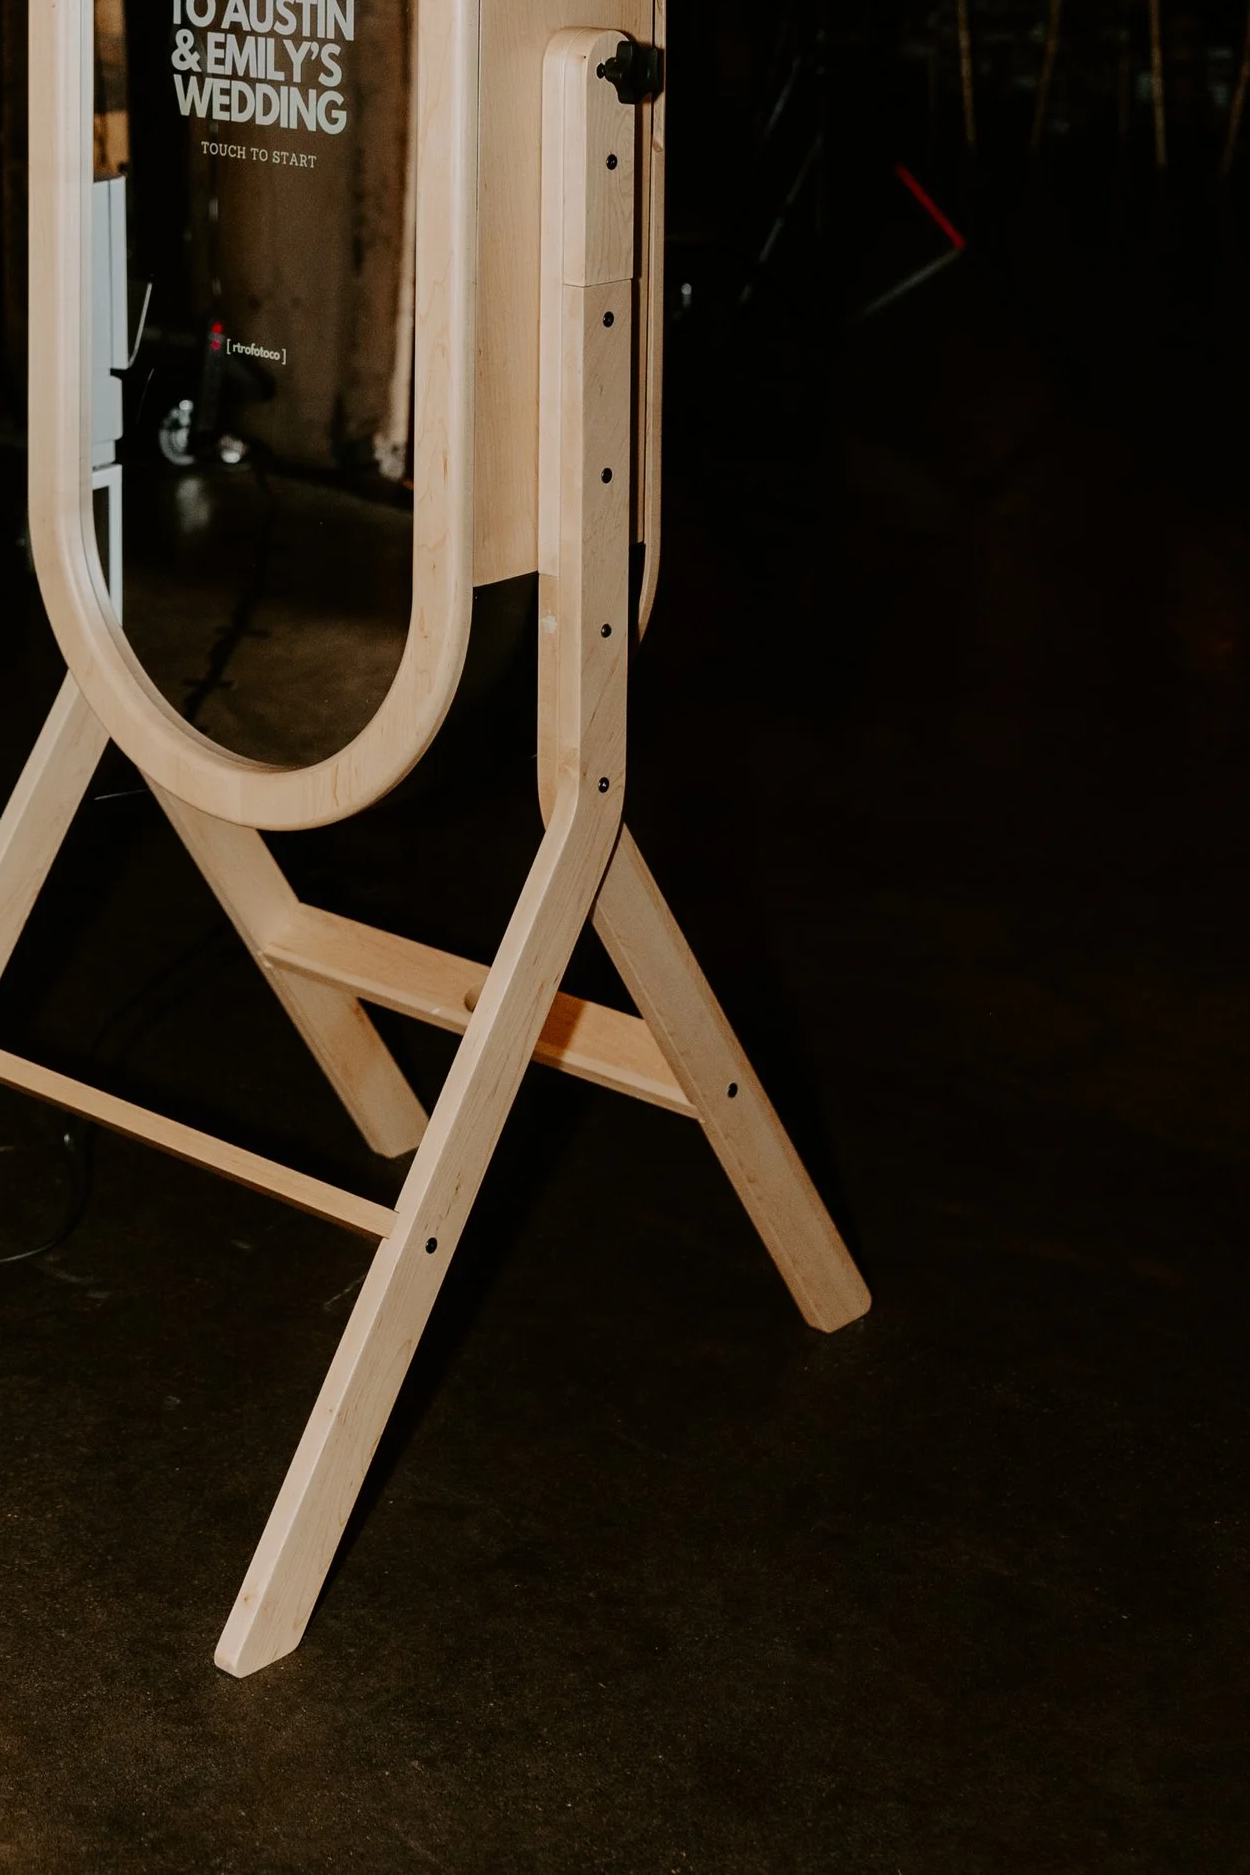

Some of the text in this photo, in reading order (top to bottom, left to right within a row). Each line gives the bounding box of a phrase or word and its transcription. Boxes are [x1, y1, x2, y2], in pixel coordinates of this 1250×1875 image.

[171, 28, 343, 87] & EMILY'S
[173, 74, 347, 135] WEDDING
[201, 141, 317, 168] TOUCH TO START
